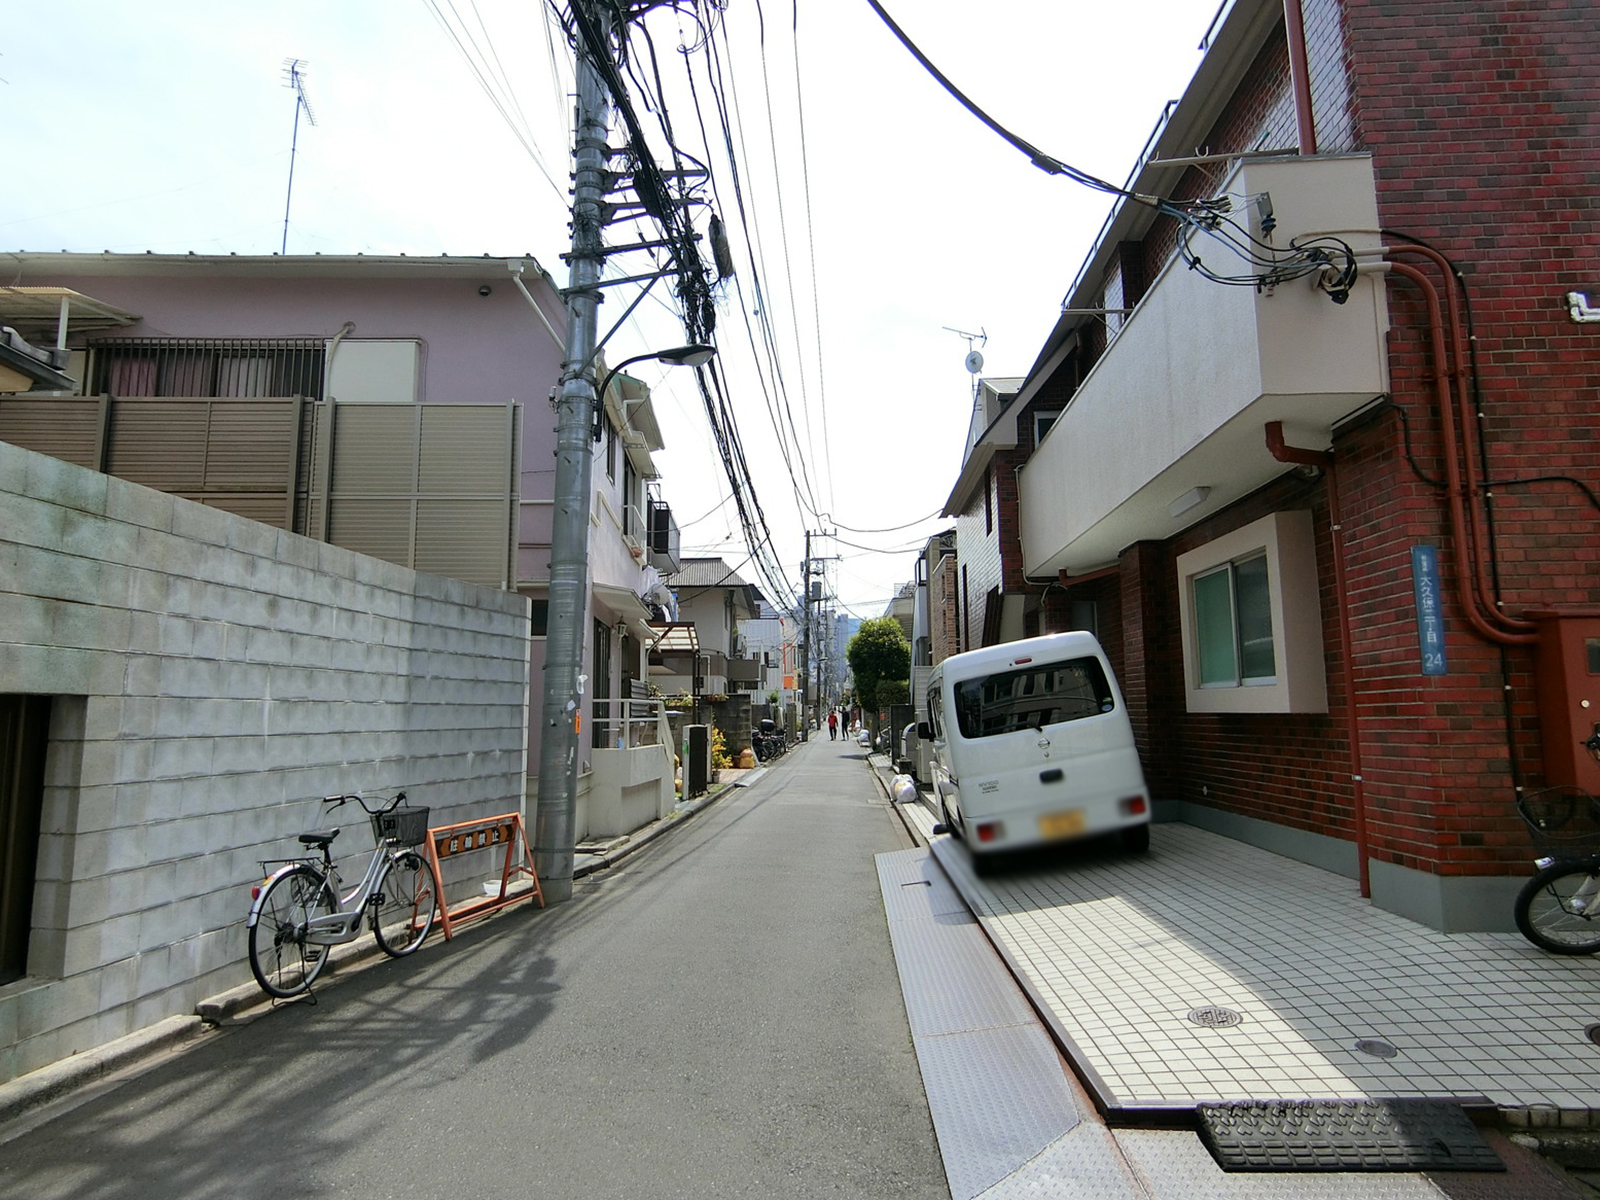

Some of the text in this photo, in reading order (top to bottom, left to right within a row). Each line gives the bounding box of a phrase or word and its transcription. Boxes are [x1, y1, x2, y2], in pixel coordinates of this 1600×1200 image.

[1420, 576, 1437, 643] 大久保二丁目
[1425, 653, 1443, 667] 24
